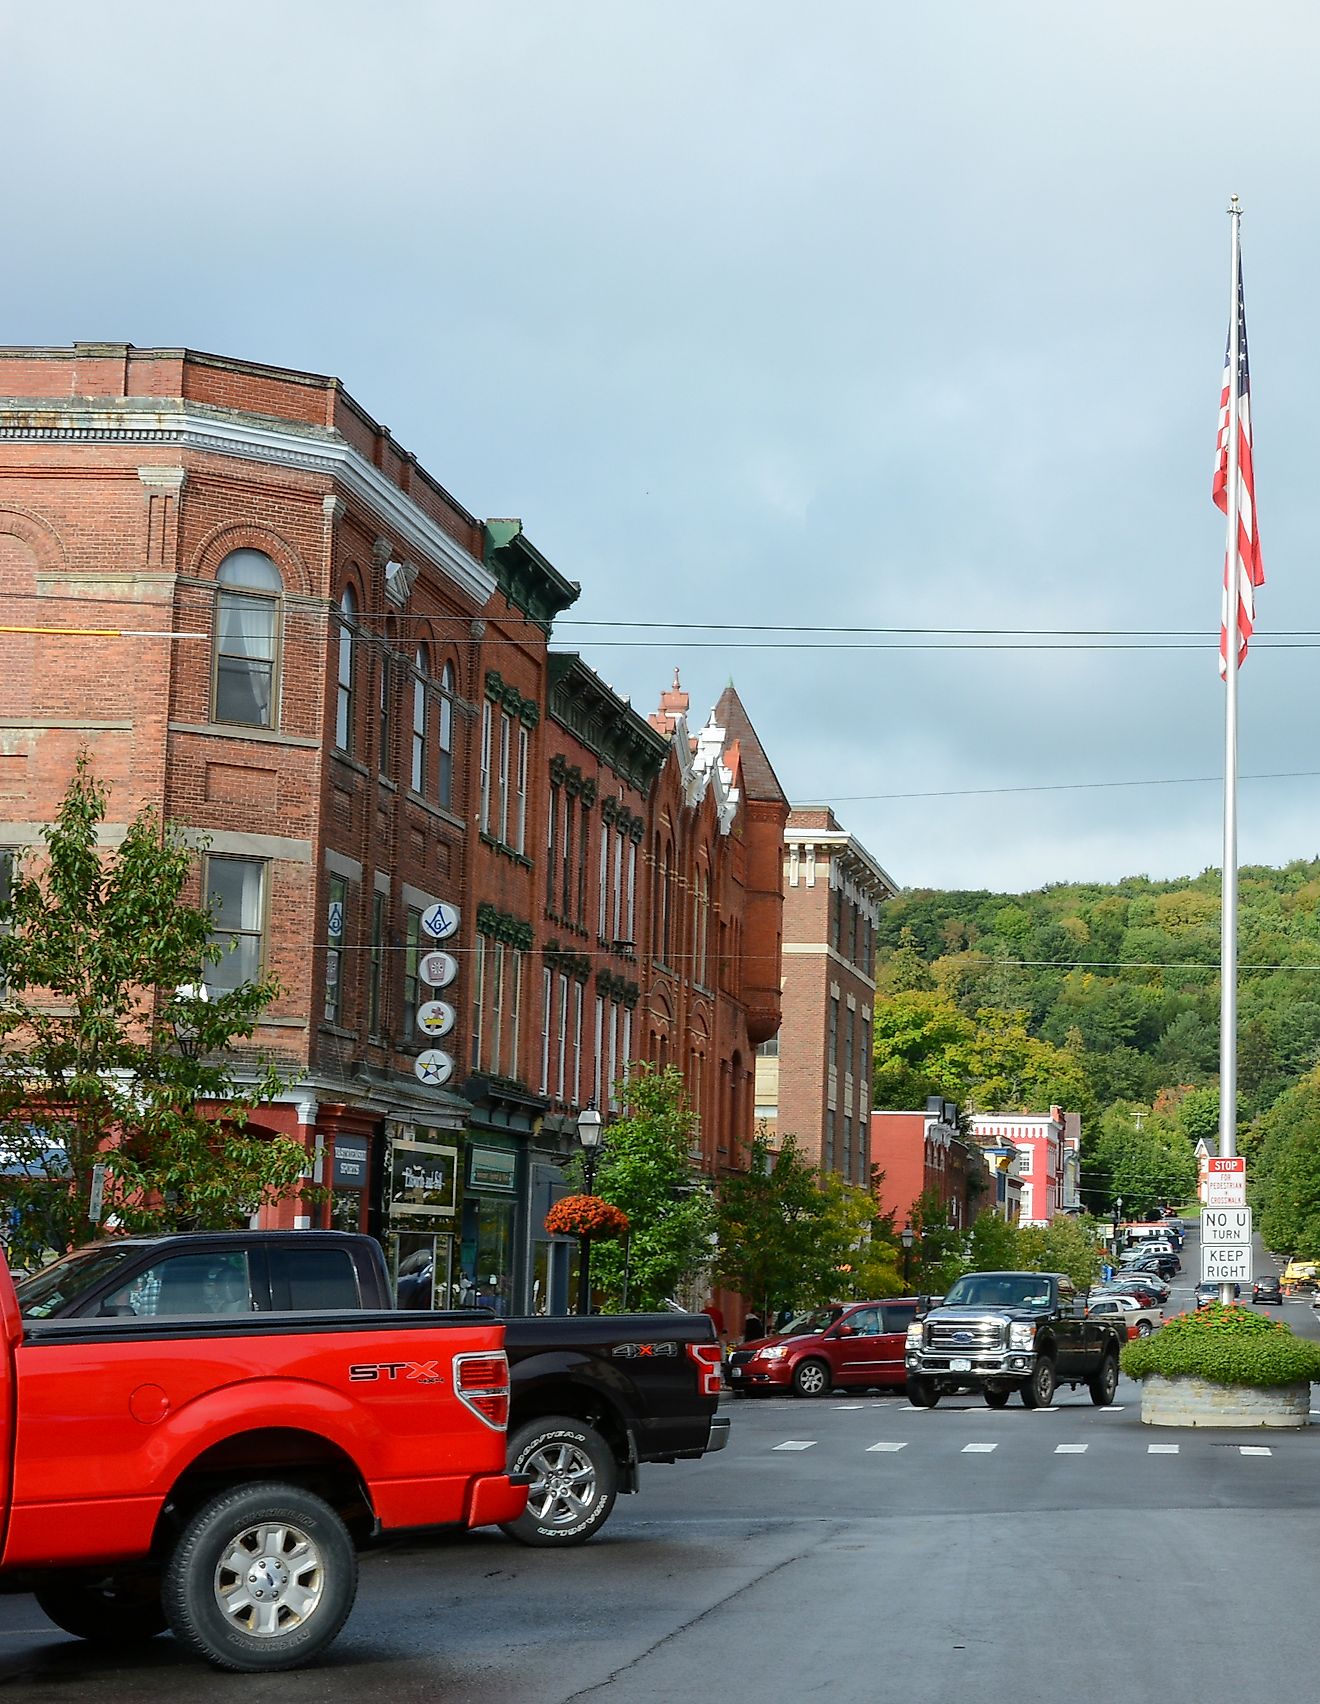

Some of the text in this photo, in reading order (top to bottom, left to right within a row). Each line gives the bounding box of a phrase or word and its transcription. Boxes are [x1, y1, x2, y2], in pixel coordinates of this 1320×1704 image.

[1214, 1161, 1237, 1171] STOP
[1206, 1213, 1246, 1226] NO U
[1212, 1230, 1240, 1239] TURN
[1210, 1250, 1243, 1262] KEEP
[1207, 1266, 1246, 1277] RIGHT
[349, 1361, 439, 1381] STX
